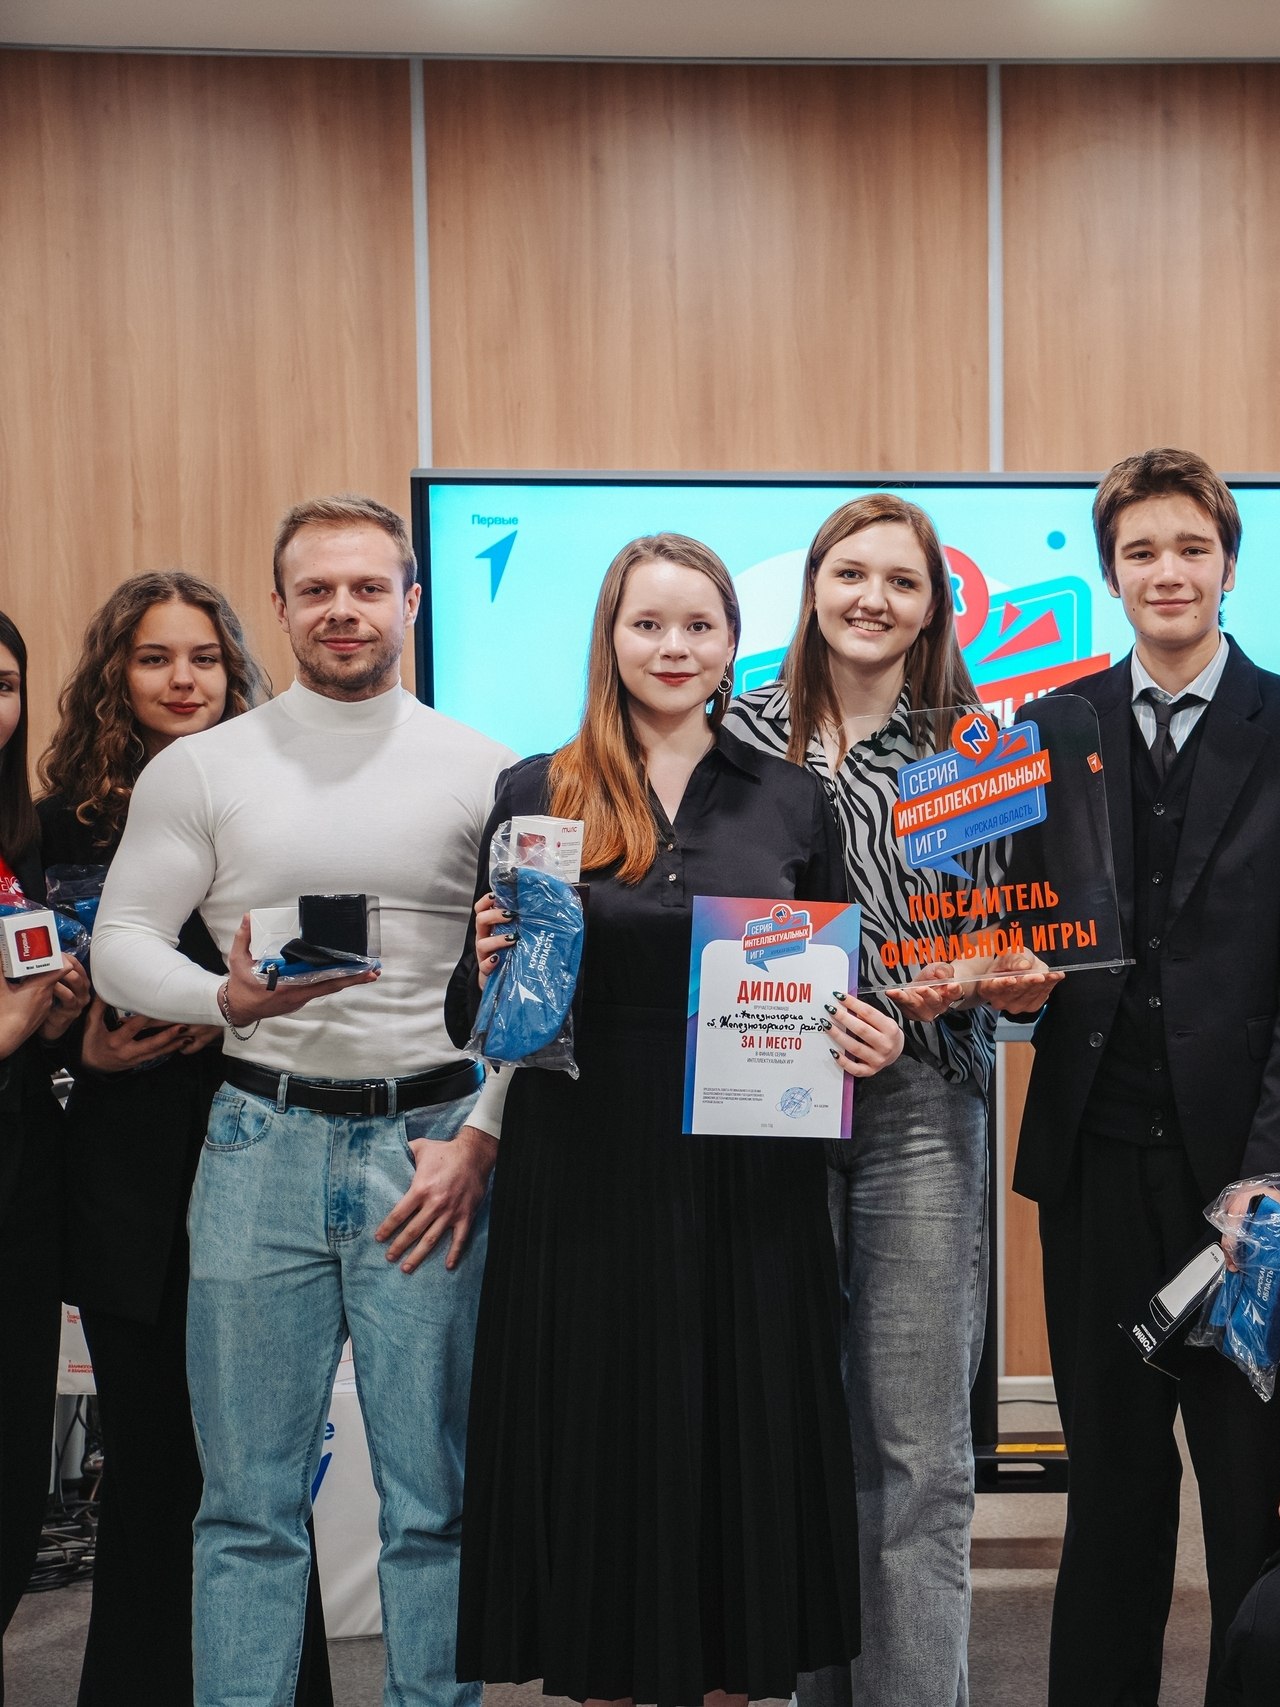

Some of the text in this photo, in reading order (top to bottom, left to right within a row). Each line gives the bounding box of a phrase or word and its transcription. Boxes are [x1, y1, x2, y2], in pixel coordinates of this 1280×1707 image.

[471, 514, 519, 528] Первые
[909, 759, 959, 795] СЕРИЯ
[897, 759, 1047, 830] ИНТЕЛЛЕКТУАЛЬНЫХ
[964, 804, 1033, 838] КУРСКАЯ ОБЛАСТЬ
[915, 828, 947, 857] ИГР
[908, 881, 1060, 922] ПОБЕДИТЕЛЬ
[744, 928, 809, 948] ИНТЕЛЛЕКТУАЛЬНЫХ
[751, 923, 773, 935] СЕРИЯ
[528, 930, 546, 969] КУРСКАЯ
[537, 932, 555, 972] ОБЛАСТЬ
[750, 950, 765, 960] ИГР
[880, 920, 1097, 969] ФИНАЛЬНОЙ ИГРЫ
[736, 980, 812, 1004] ДИПЛОМ
[741, 1035, 755, 1048] ЗА
[765, 1036, 802, 1050] МЕСТО
[1262, 1270, 1274, 1302] ОБЛАСТЬ
[1132, 1325, 1154, 1352] FORMA
